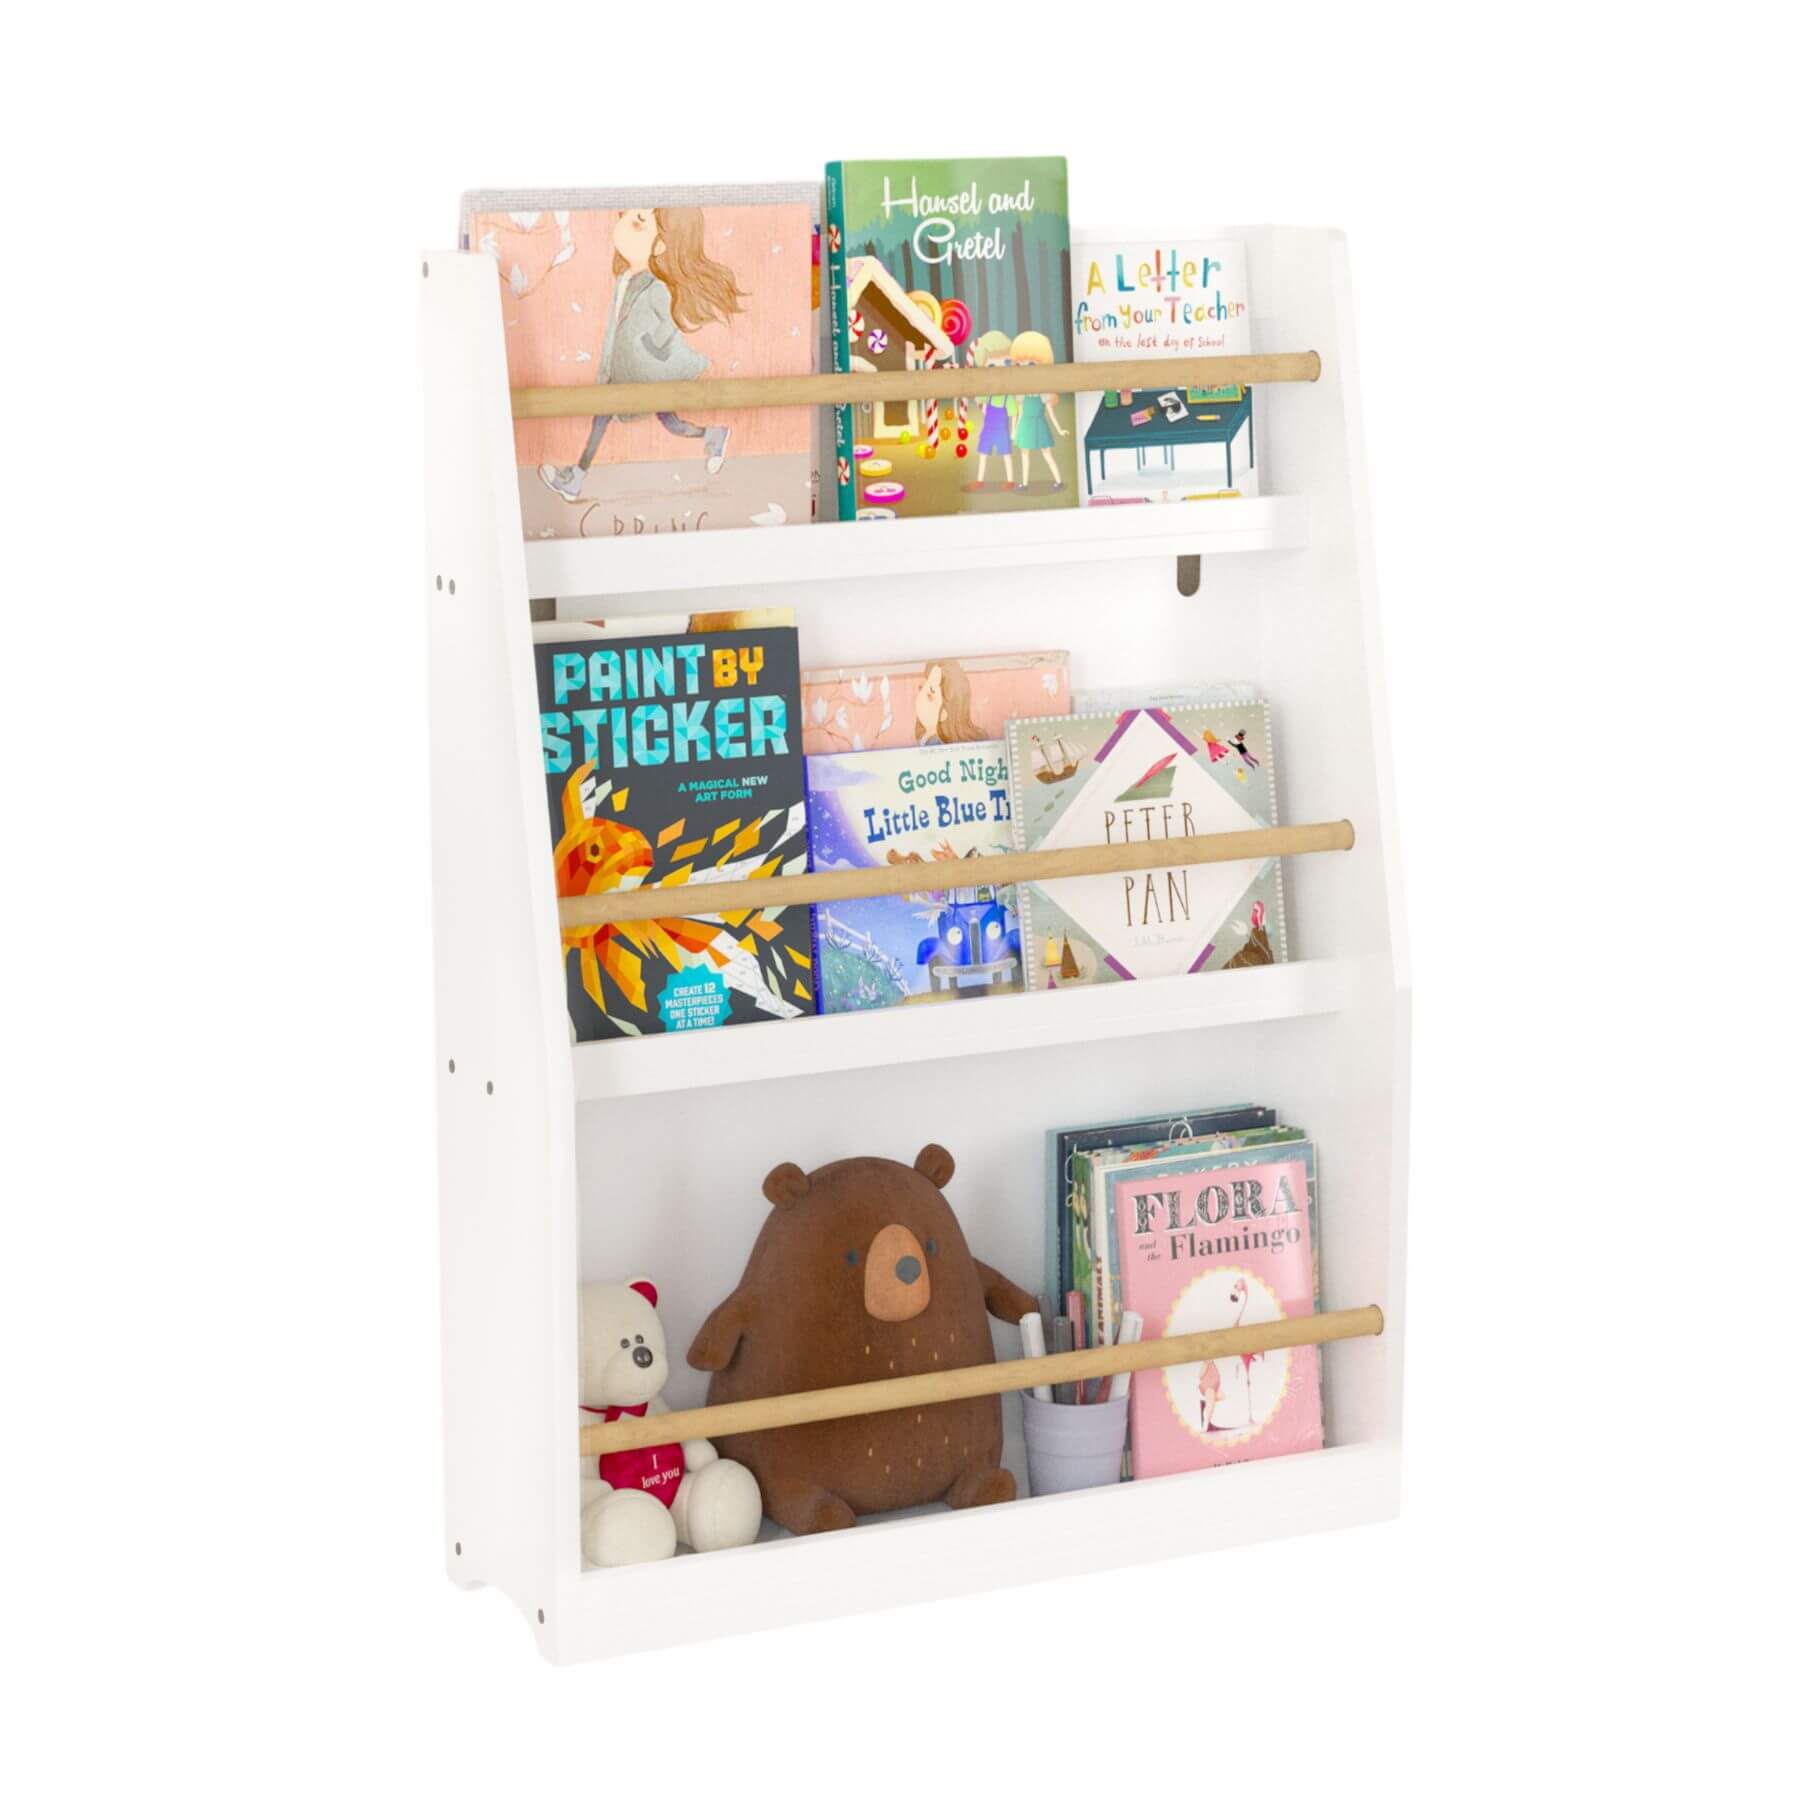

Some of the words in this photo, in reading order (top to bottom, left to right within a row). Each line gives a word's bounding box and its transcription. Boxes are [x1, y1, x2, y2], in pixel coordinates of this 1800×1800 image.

[881, 175, 983, 219] Hansel
[988, 179, 1035, 215] and
[913, 217, 1006, 266] Gretel
[1087, 260, 1105, 296] A
[1115, 249, 1222, 293] Letter
[1075, 301, 1117, 335] from
[1119, 304, 1162, 330] your
[1164, 290, 1245, 324] Teacher
[1115, 336, 1132, 348] the
[1137, 333, 1157, 348] last
[1164, 335, 1179, 351] day
[1184, 336, 1195, 348] of
[552, 643, 706, 704] PAINT
[712, 646, 765, 688] BY
[540, 694, 790, 774] STICKER
[678, 783, 687, 793] A
[689, 778, 739, 791] MAGICAL
[742, 775, 769, 787] NEW
[898, 760, 951, 793] Good
[959, 757, 1008, 786] Nigh
[695, 791, 718, 803] ART
[720, 788, 753, 800] FORM
[864, 804, 930, 843] Little
[935, 795, 987, 827] Blue
[1123, 870, 1190, 927] PAN
[665, 994, 724, 1009] MASTERPIECES
[673, 985, 703, 997] CREATE
[704, 982, 716, 994] 12
[670, 1008, 686, 1019] ONE
[687, 1005, 720, 1018] STICKER
[676, 1019, 686, 1030] AT
[686, 1018, 693, 1028] A
[1133, 1175, 1302, 1235] FLORA
[1138, 1240, 1157, 1251] and
[1170, 1226, 1301, 1261] Flamingo
[641, 1475, 660, 1489] love
[662, 1466, 680, 1485] you
[652, 1454, 658, 1470] I
